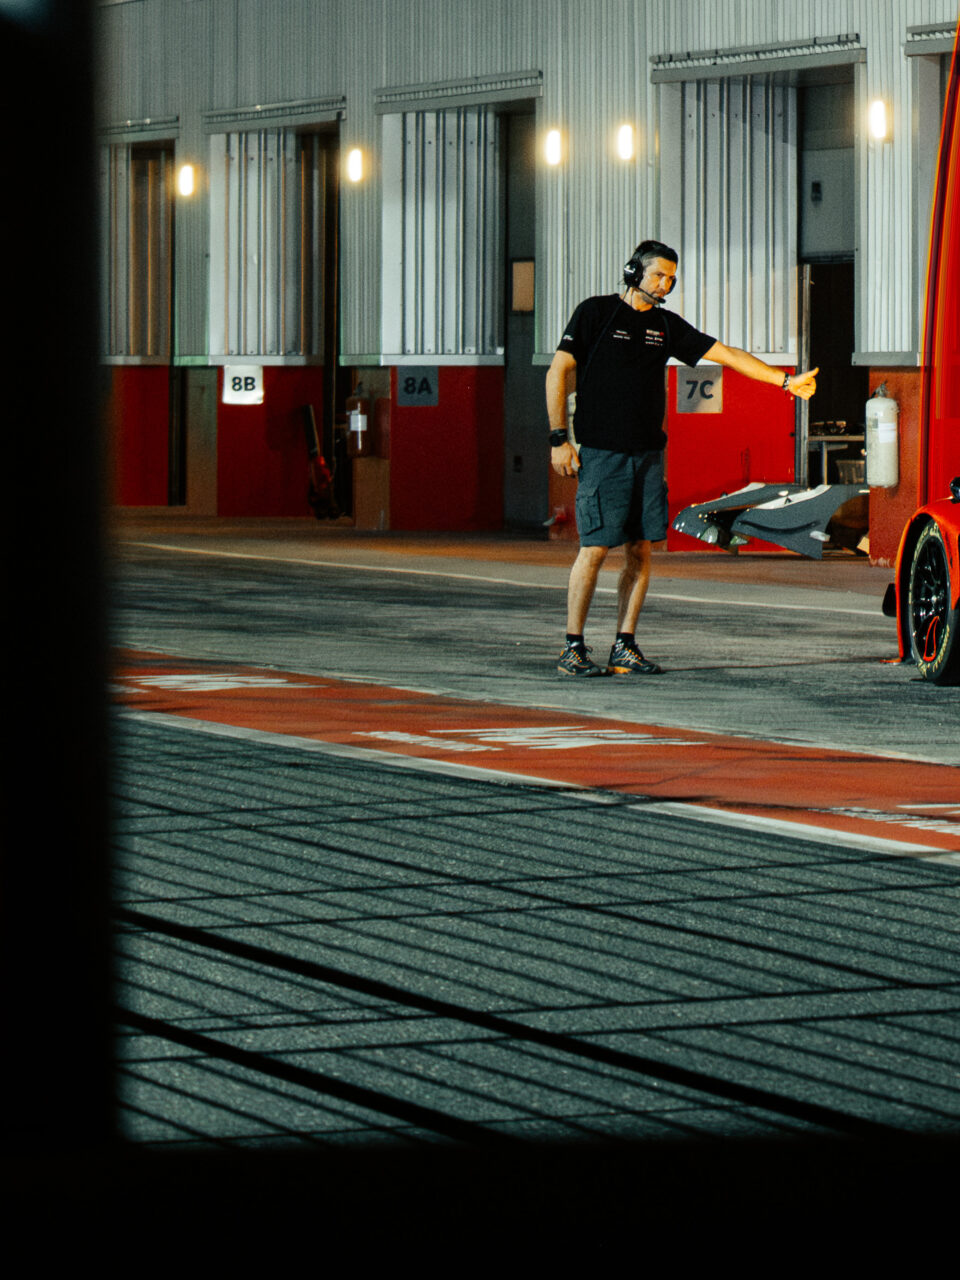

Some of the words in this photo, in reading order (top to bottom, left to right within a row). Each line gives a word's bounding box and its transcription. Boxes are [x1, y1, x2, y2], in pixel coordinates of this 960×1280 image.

[231, 376, 256, 392] 8B
[403, 377, 433, 395] 8A
[686, 380, 714, 400] 7C
